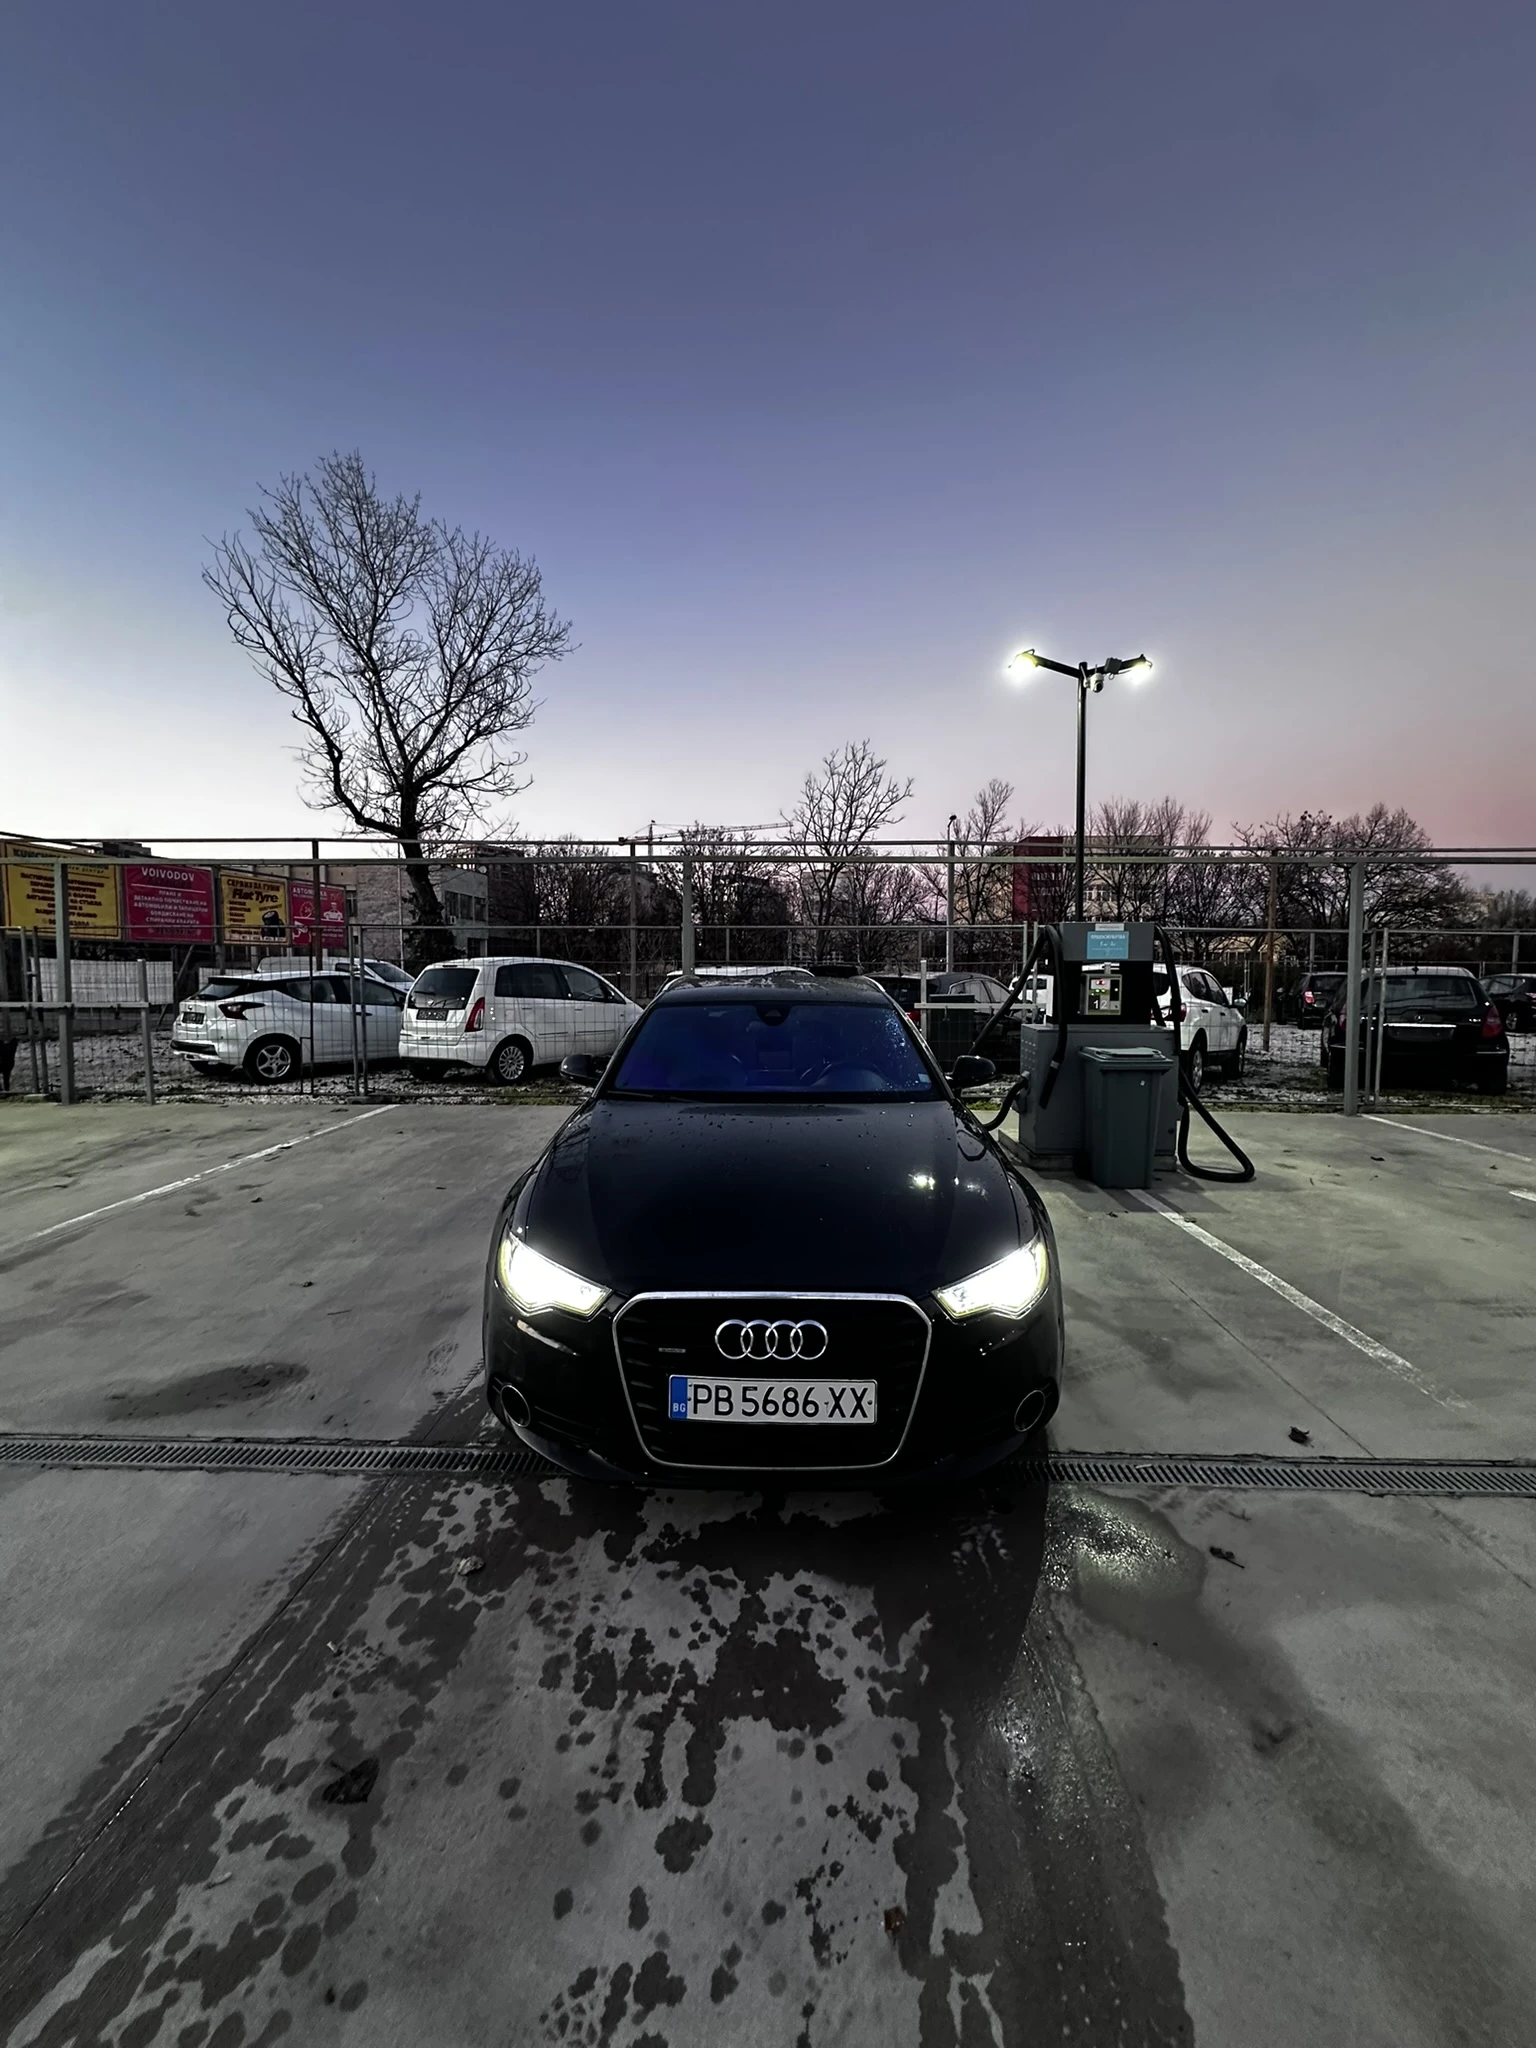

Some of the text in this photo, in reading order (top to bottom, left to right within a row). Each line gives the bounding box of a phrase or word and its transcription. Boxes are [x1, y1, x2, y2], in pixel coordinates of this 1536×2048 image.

[141, 866, 195, 882] VOIVODOV
[227, 878, 252, 888] СЕРВИЗ
[232, 888, 254, 900] Flat
[255, 890, 279, 904] Tyre
[1093, 1000, 1099, 1009] 1
[1100, 1000, 1108, 1010] 2
[672, 1383, 869, 1419] BG PB 5686 XX
